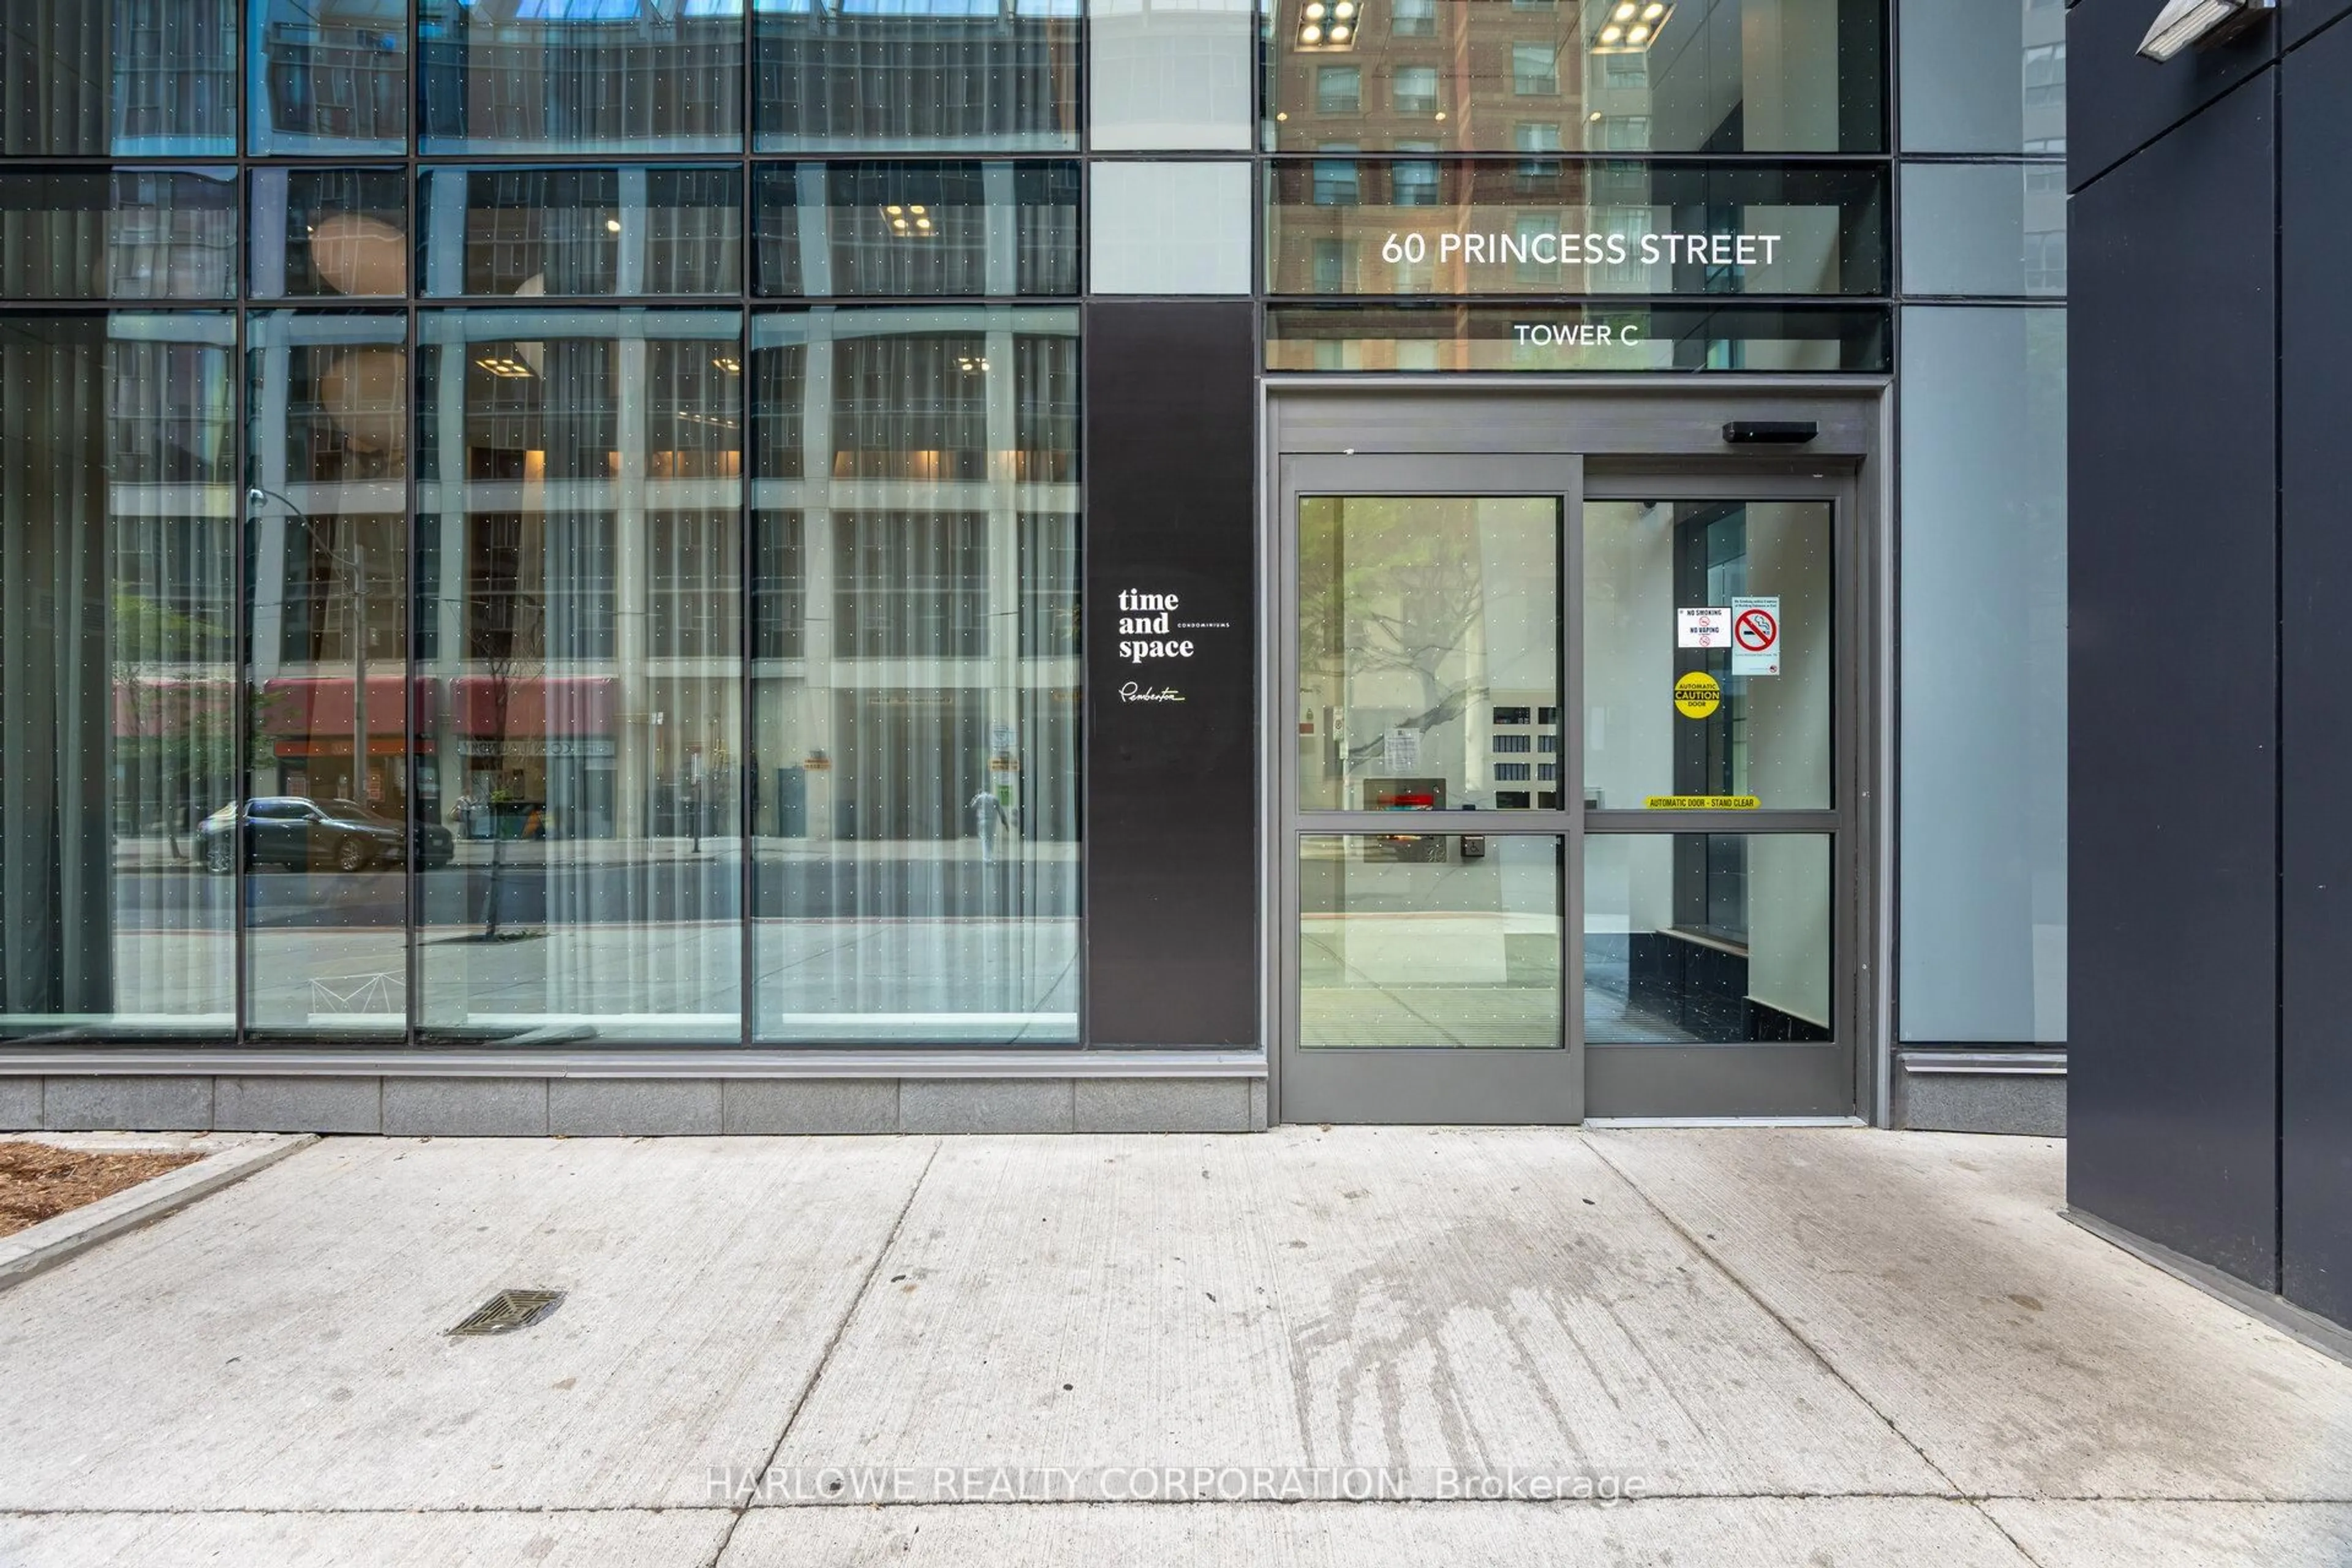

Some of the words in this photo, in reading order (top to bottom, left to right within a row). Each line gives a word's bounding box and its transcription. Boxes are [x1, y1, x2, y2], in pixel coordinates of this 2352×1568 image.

[1382, 233, 1425, 263] 60
[1441, 233, 1627, 264] PRINCESS
[1641, 234, 1781, 264] STREET
[1514, 325, 1611, 345] TOWER
[1621, 325, 1638, 346] C
[1118, 588, 1179, 611] time
[1118, 612, 1169, 635] and
[1119, 640, 1194, 664] space
[1675, 691, 1720, 699] CAUTION
[1649, 798, 1686, 807] AUTOMATIC
[1688, 798, 1705, 807] DOOR
[1711, 798, 1732, 807] STAND
[1733, 798, 1754, 807] CLEAR
